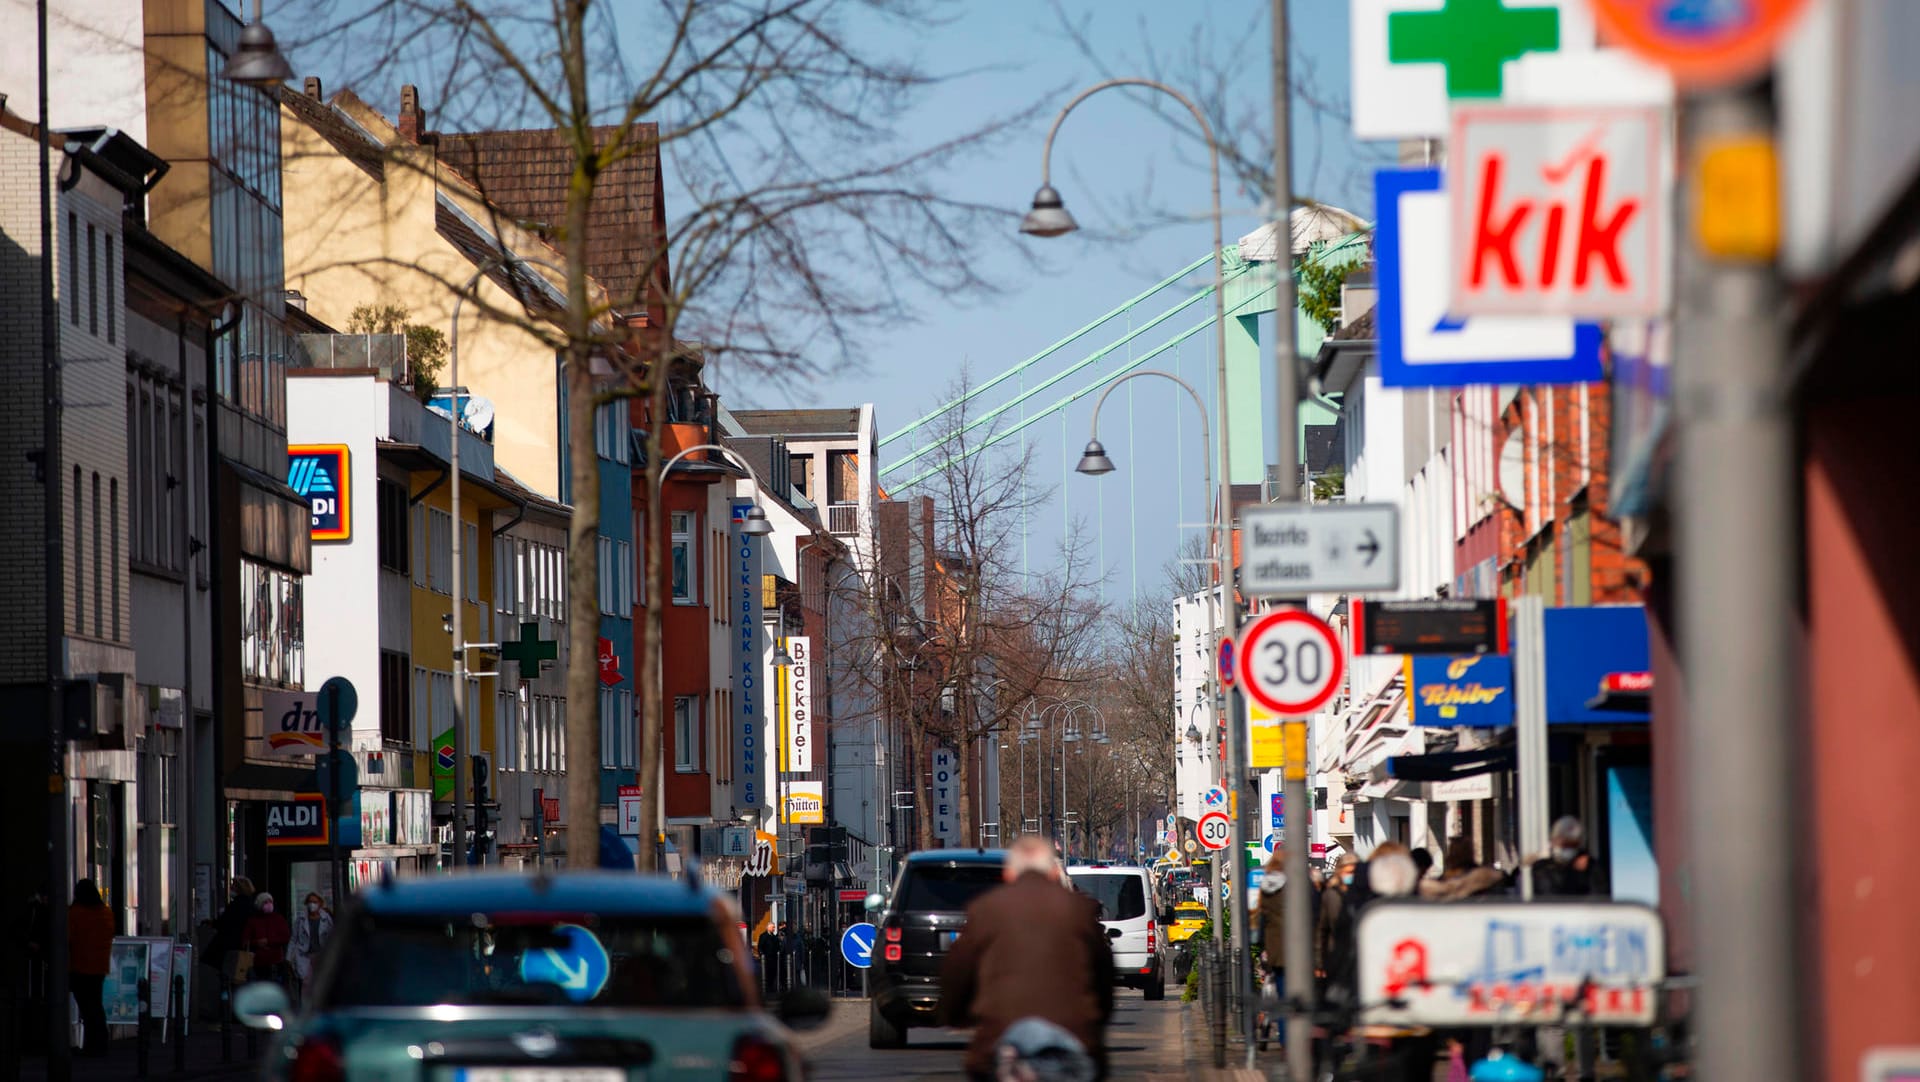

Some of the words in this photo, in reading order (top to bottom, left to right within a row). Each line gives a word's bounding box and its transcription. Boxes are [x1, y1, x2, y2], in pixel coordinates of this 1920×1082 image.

[1465, 122, 1640, 293] kik
[740, 534, 752, 652] VOLKSBANK
[1262, 638, 1322, 686] 30
[742, 662, 753, 715] KÖLN
[793, 643, 806, 766] Bäckerei
[1420, 682, 1506, 706] Tchibo
[743, 723, 754, 774] BONN
[267, 805, 318, 826] ALDI
[744, 782, 755, 804] eG
[937, 754, 949, 832] HOTEL
[1205, 822, 1227, 839] 30
